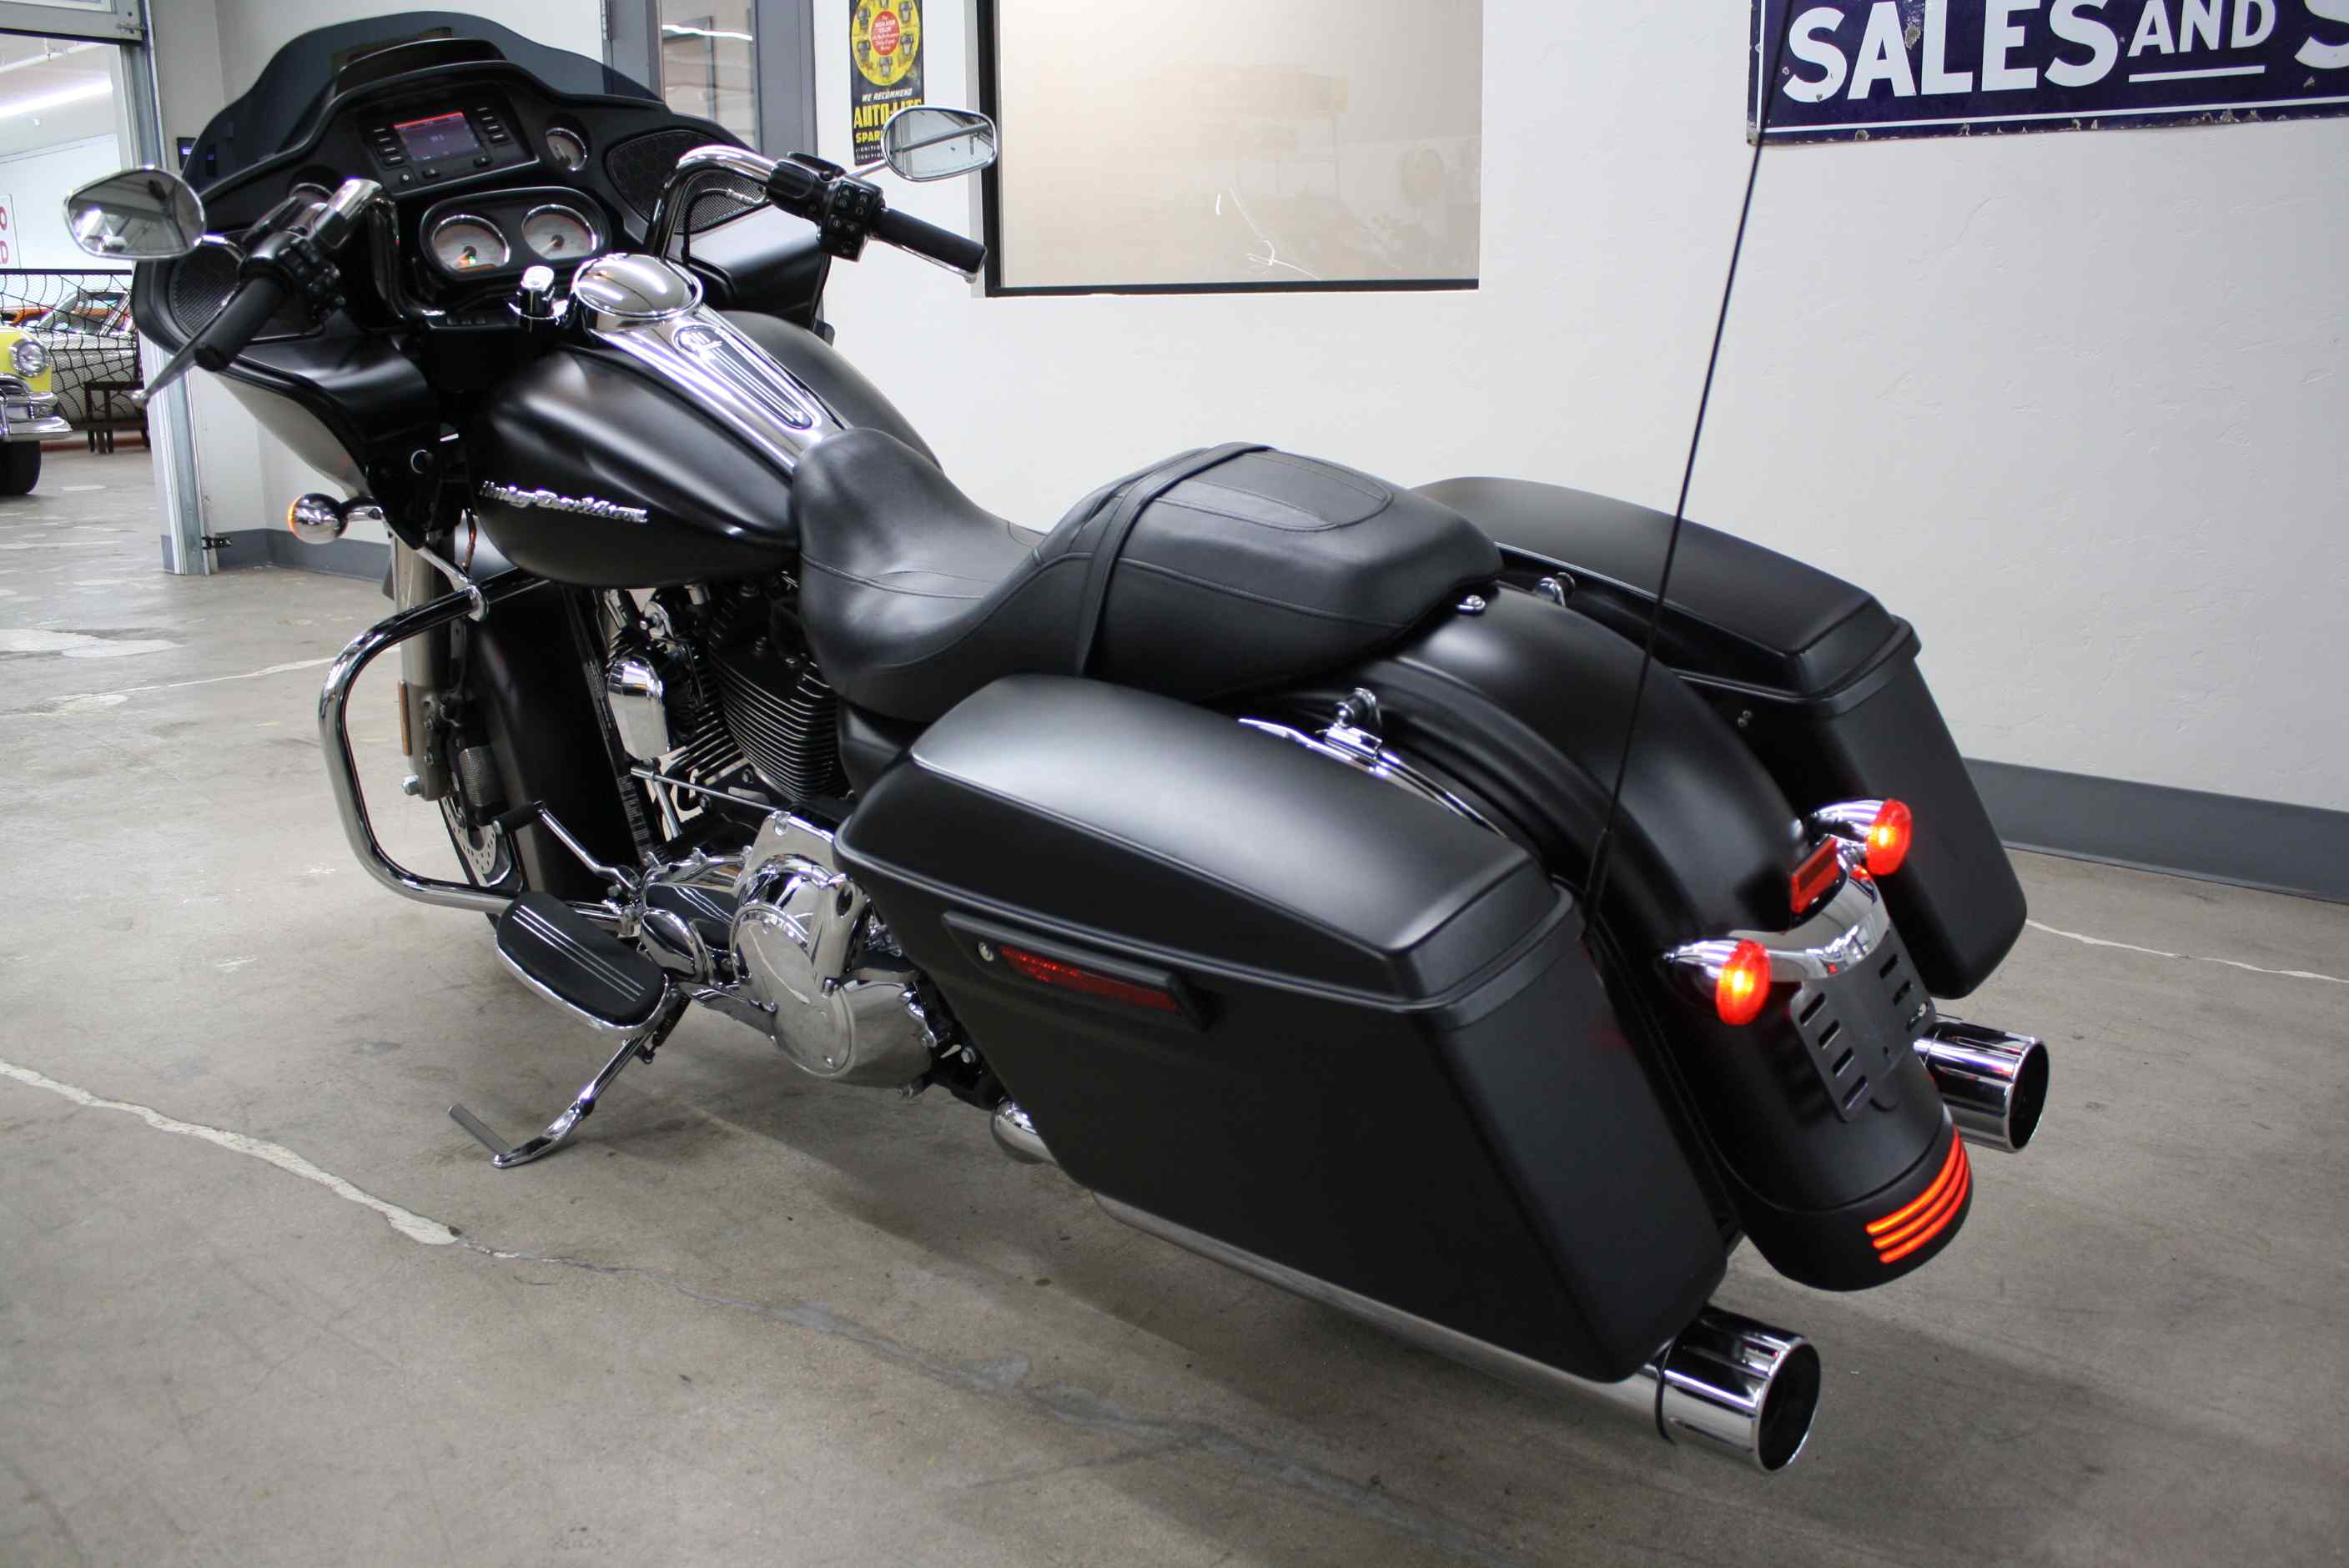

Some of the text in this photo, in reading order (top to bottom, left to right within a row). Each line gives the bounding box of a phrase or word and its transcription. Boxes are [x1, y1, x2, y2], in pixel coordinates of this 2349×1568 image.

[1783, 0, 2119, 103] SALES
[2127, 0, 2276, 57] AND
[862, 88, 913, 103] WE RECOMMEND
[854, 98, 922, 128] AUTO-
[856, 130, 882, 143] SPAR
